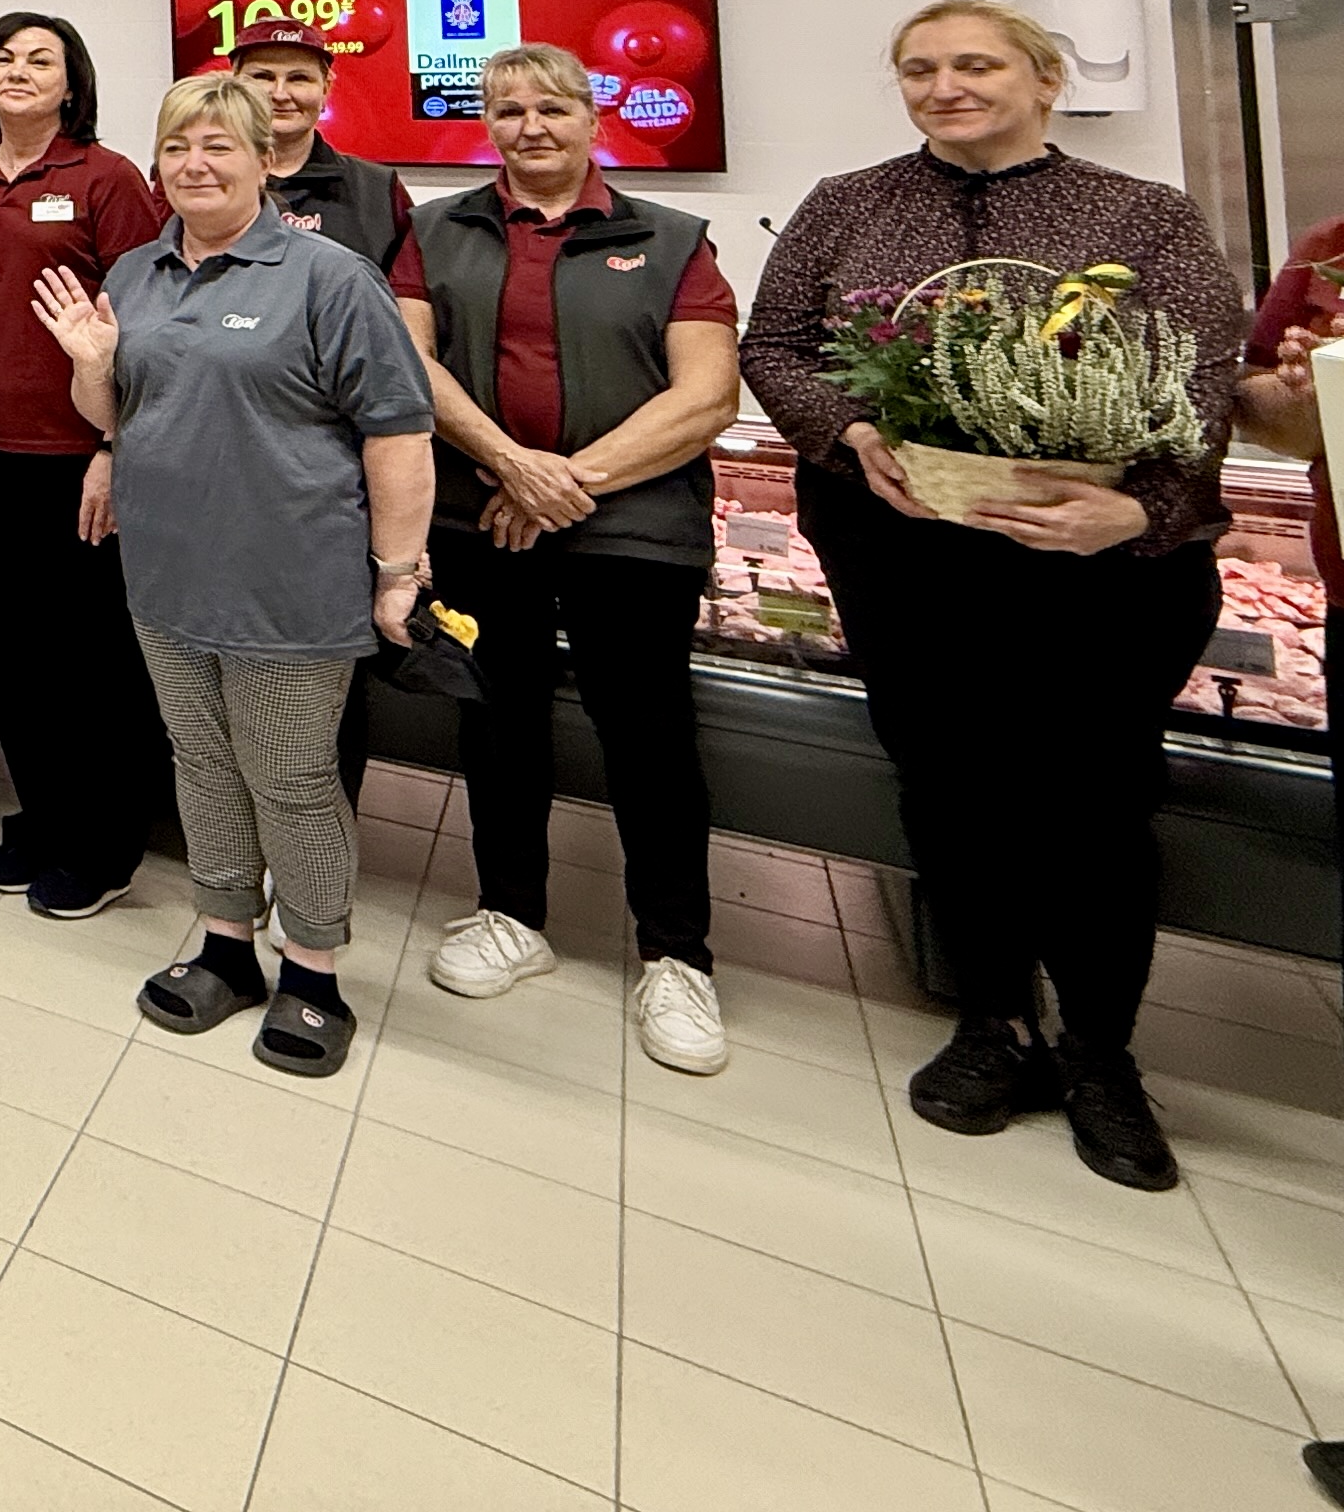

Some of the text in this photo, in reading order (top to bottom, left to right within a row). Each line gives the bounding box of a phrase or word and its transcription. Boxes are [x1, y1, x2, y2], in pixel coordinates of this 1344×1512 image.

[417, 54, 491, 69] Dallma
[420, 73, 483, 90] prodo
[619, 102, 689, 119] NAUDA
